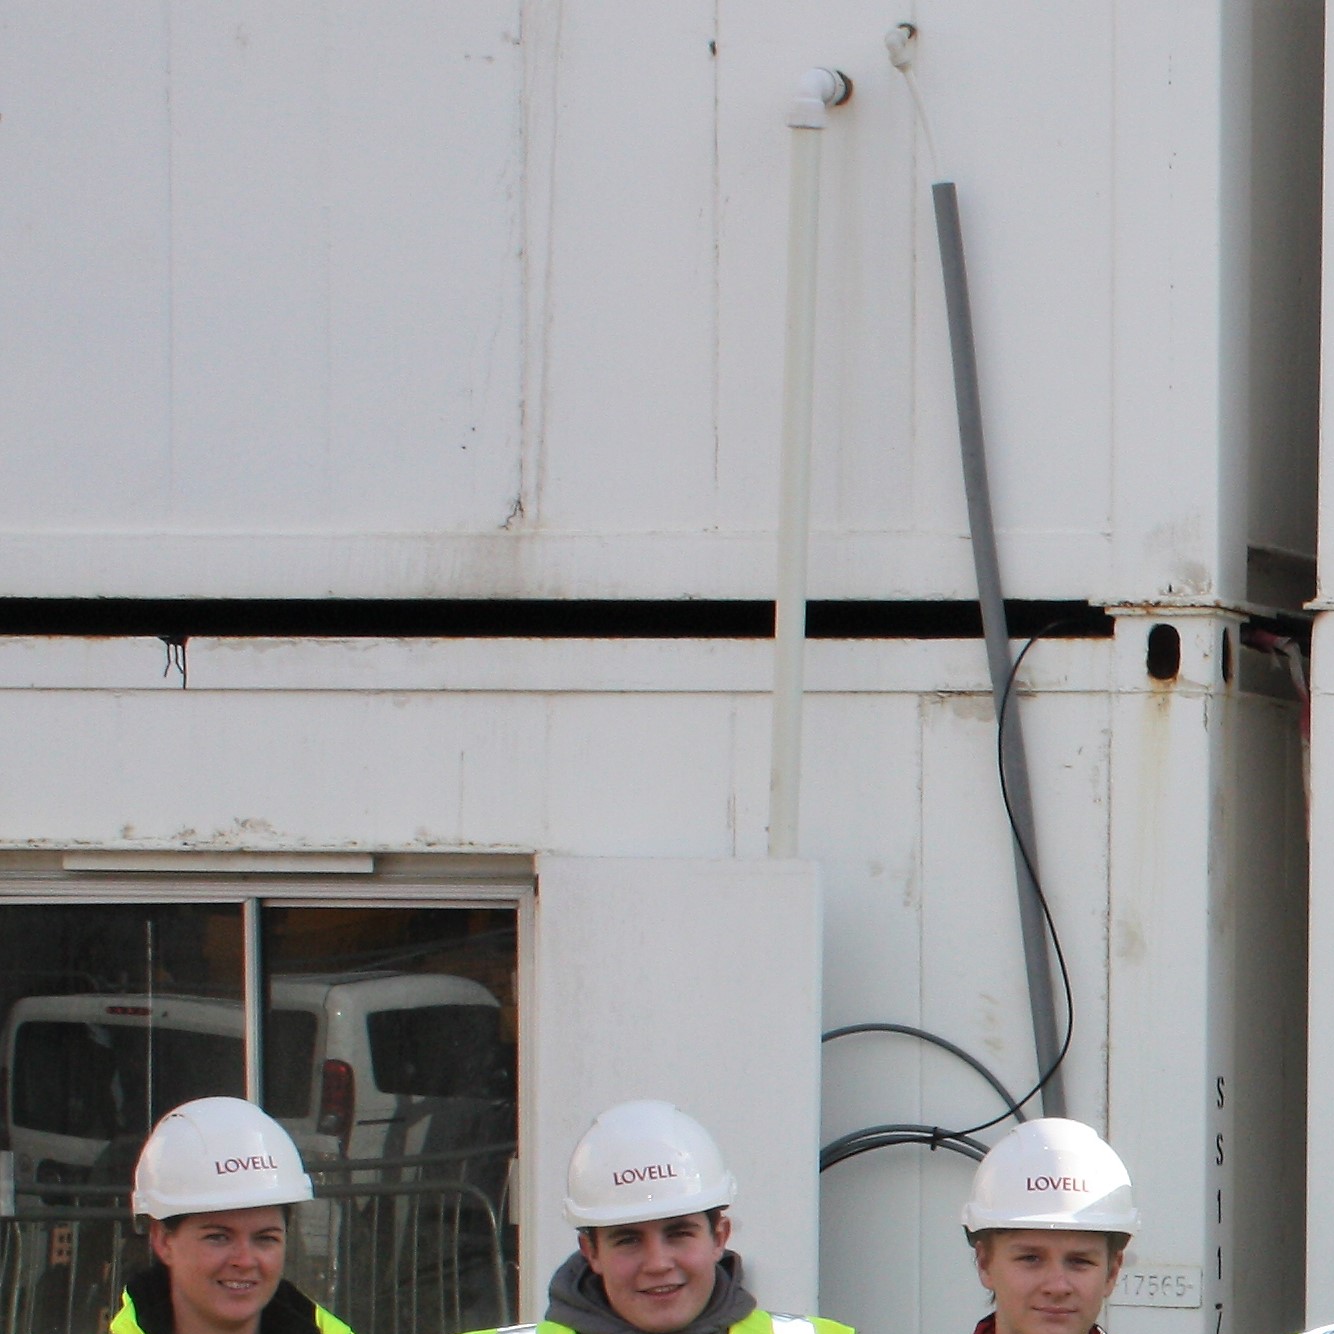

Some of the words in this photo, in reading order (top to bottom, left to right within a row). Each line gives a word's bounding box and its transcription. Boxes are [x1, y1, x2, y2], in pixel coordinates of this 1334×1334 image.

[215, 1157, 278, 1175] LOVELL
[613, 1164, 677, 1186] LOVELL
[1026, 1176, 1090, 1193] LOVELL
